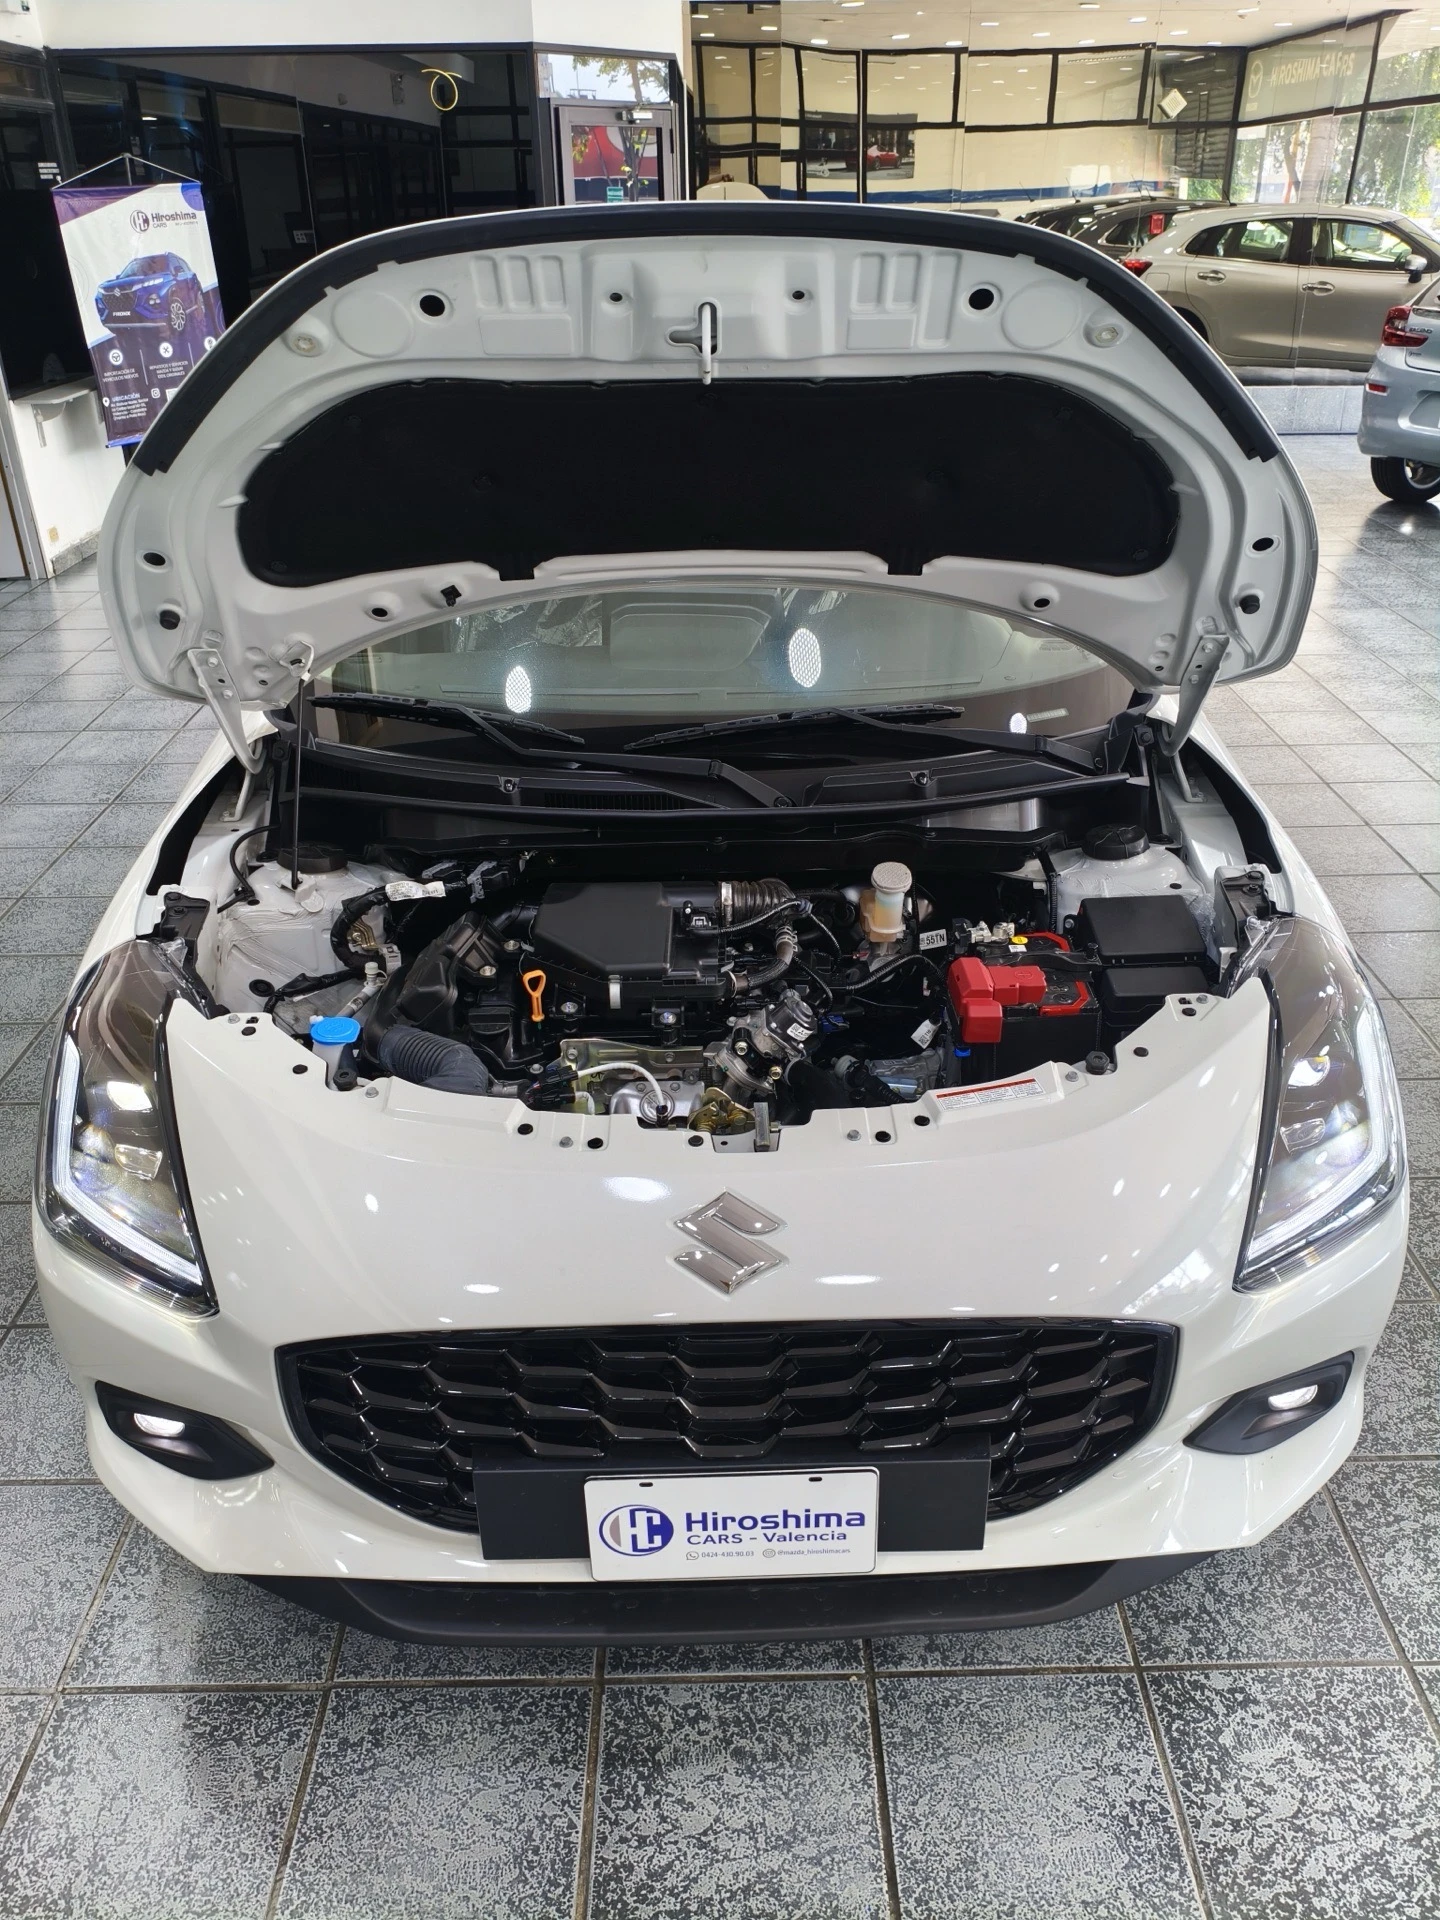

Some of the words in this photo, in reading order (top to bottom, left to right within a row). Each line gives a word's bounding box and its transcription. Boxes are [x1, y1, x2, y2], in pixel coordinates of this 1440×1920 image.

[151, 211, 197, 222] Hiroshima
[686, 1508, 866, 1532] Hiroshima
[686, 1533, 743, 1546] CARS
[763, 1530, 848, 1542] Valencia
